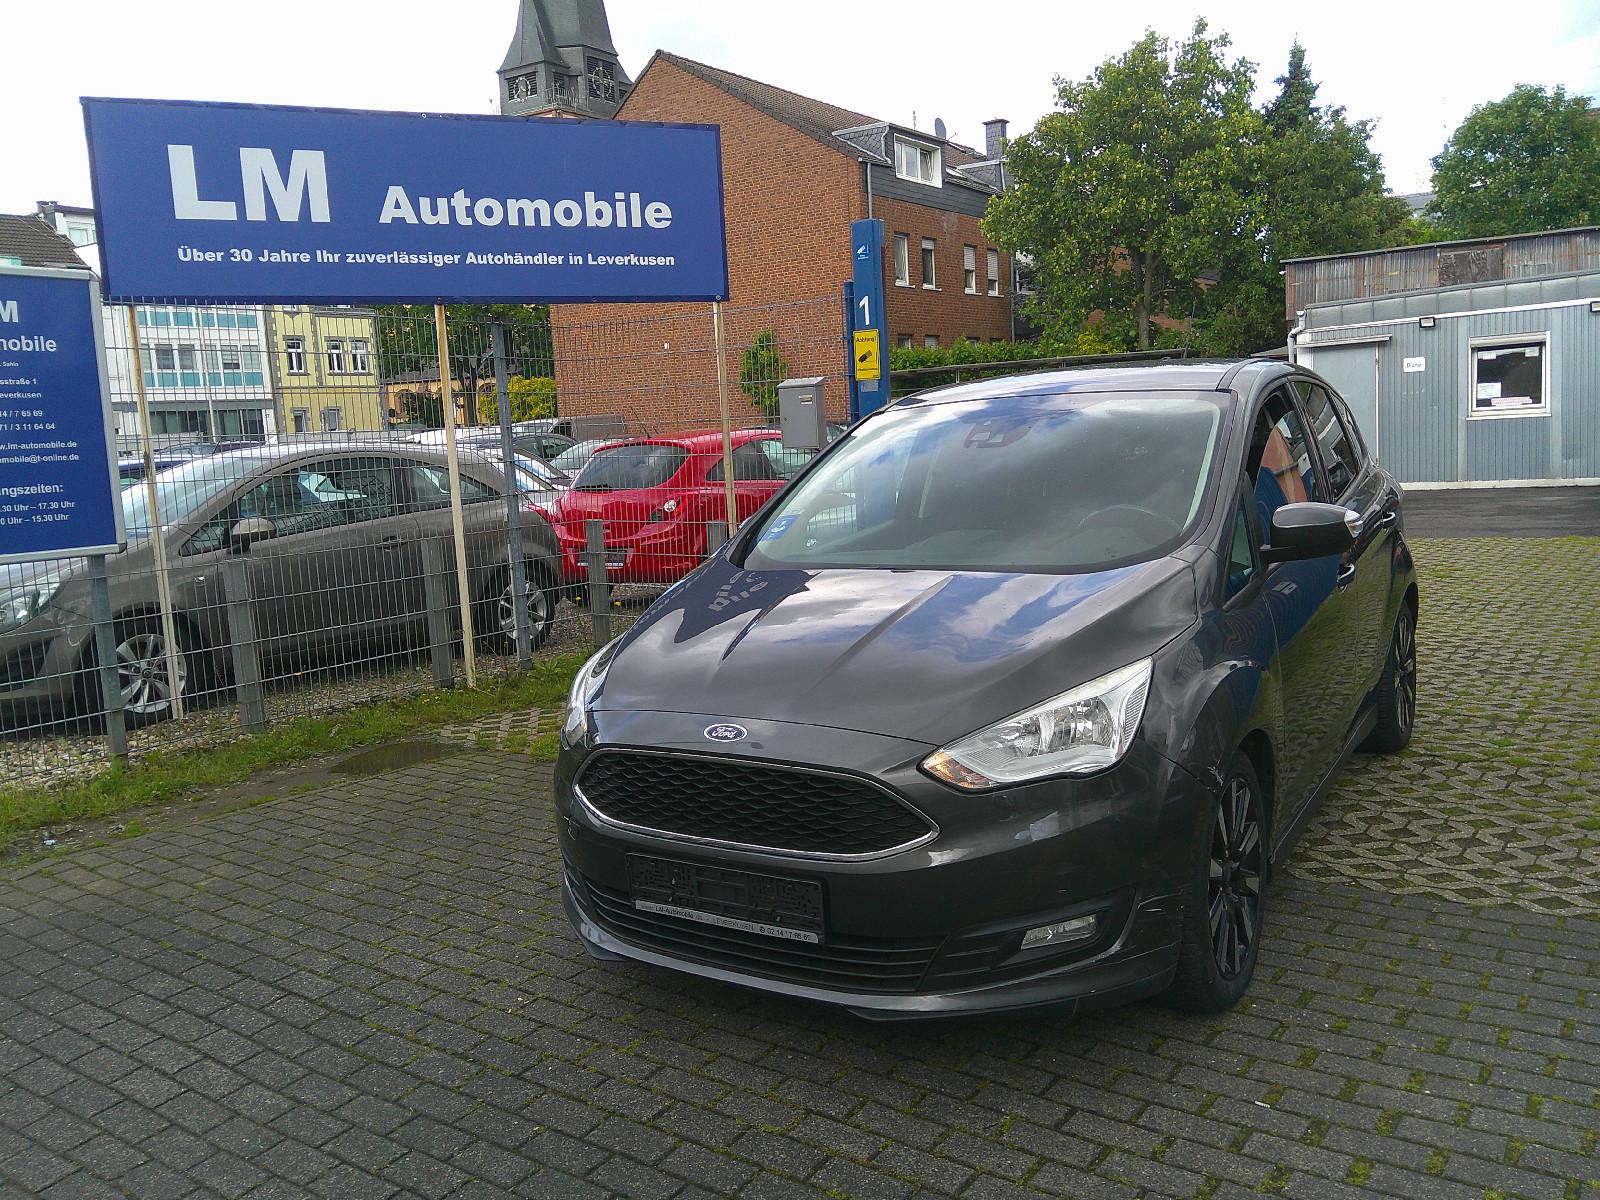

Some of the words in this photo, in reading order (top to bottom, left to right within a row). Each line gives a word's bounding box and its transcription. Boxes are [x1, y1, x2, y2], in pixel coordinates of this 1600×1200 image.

[167, 143, 330, 223] LM
[378, 184, 673, 229] Automobile
[177, 245, 224, 262] Über
[229, 248, 252, 262] 30
[258, 249, 311, 263] Jahre
[316, 250, 341, 263] Ihr
[345, 250, 460, 267] zuverlässiger
[465, 251, 564, 265] Autohändler
[568, 252, 583, 265] in
[587, 252, 675, 266] Leverkusen
[859, 295, 870, 325] 1
[15, 423, 21, 431] 3
[14, 503, 29, 512] Uhr
[38, 501, 59, 510] 17.30
[60, 500, 75, 508] Uhr
[7, 516, 23, 525] Uhr
[32, 514, 53, 523] 15.30
[54, 513, 70, 521] Uhr
[712, 726, 737, 739] Ford
